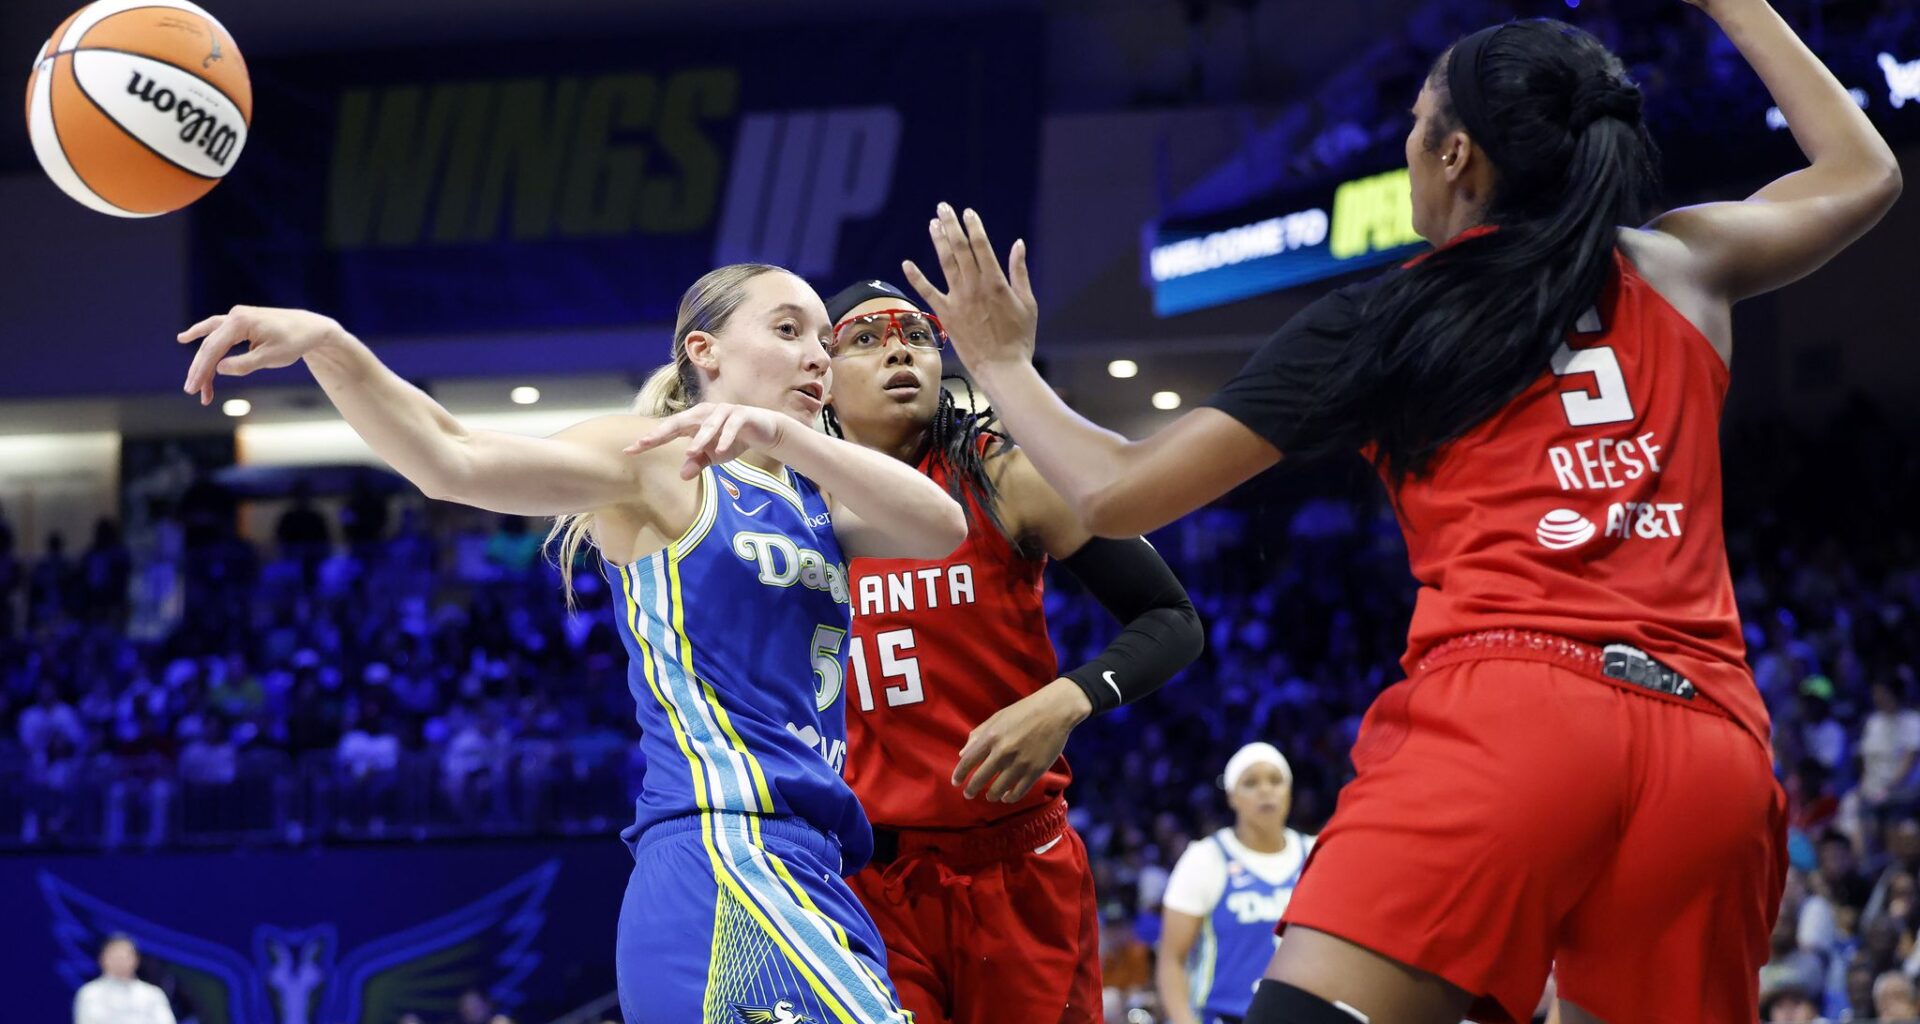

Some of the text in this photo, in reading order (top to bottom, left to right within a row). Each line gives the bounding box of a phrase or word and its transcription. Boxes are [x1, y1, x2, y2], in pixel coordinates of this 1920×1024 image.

[125, 70, 238, 167] Wilson
[325, 68, 738, 249] WINGS
[712, 106, 901, 278] UP
[1548, 431, 1661, 490] REESE
[1604, 502, 1684, 539] AT&T
[850, 563, 975, 619] ANTA
[810, 624, 848, 712] 5
[848, 627, 926, 712] 15
